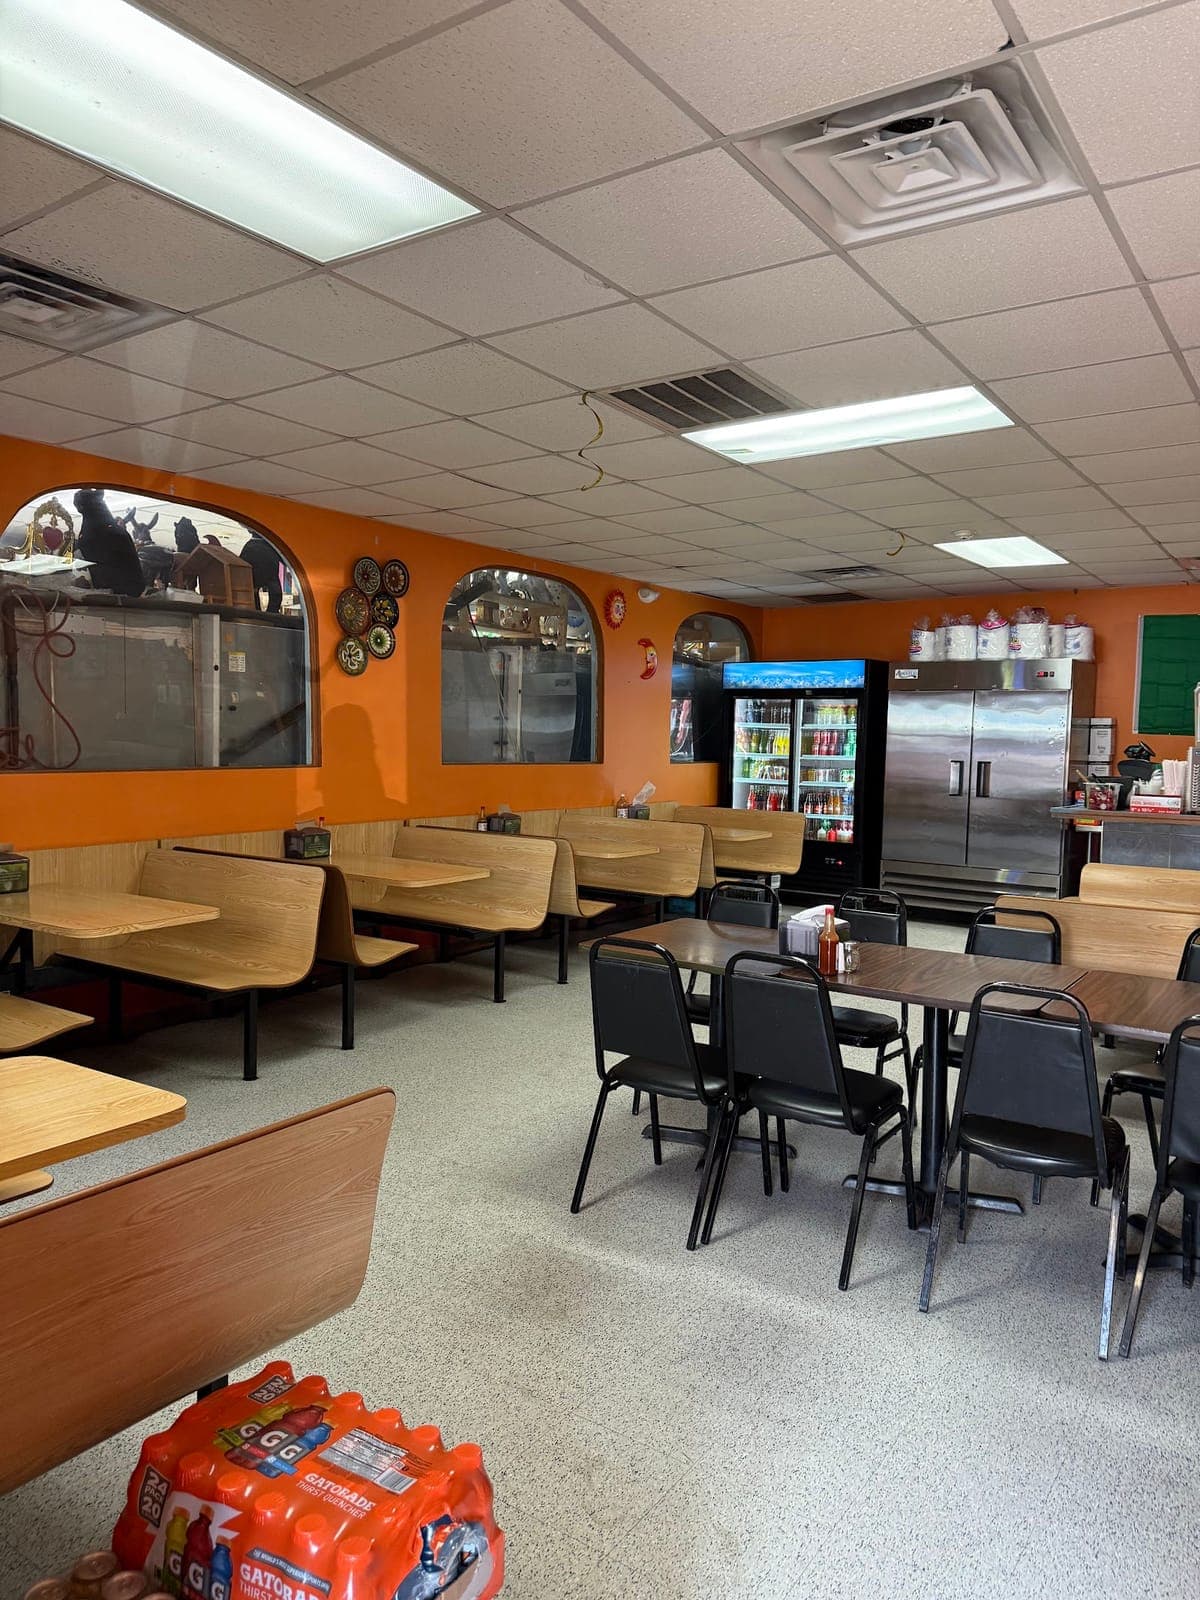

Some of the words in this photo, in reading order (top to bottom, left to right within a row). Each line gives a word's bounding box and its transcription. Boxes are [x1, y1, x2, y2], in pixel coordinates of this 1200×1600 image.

[253, 1389, 276, 1400] 20
[240, 1423, 261, 1438] G
[260, 1430, 288, 1447] G
[280, 1444, 302, 1460] G
[148, 1470, 169, 1493] 24
[296, 1480, 325, 1498] THIRST
[322, 1494, 367, 1519] QUENCHER
[304, 1473, 376, 1511] GATORADE
[141, 1497, 160, 1518] 20
[169, 1554, 181, 1574] G
[188, 1563, 203, 1590] G
[240, 1563, 320, 1600] GATORA
[211, 1582, 224, 1600] G
